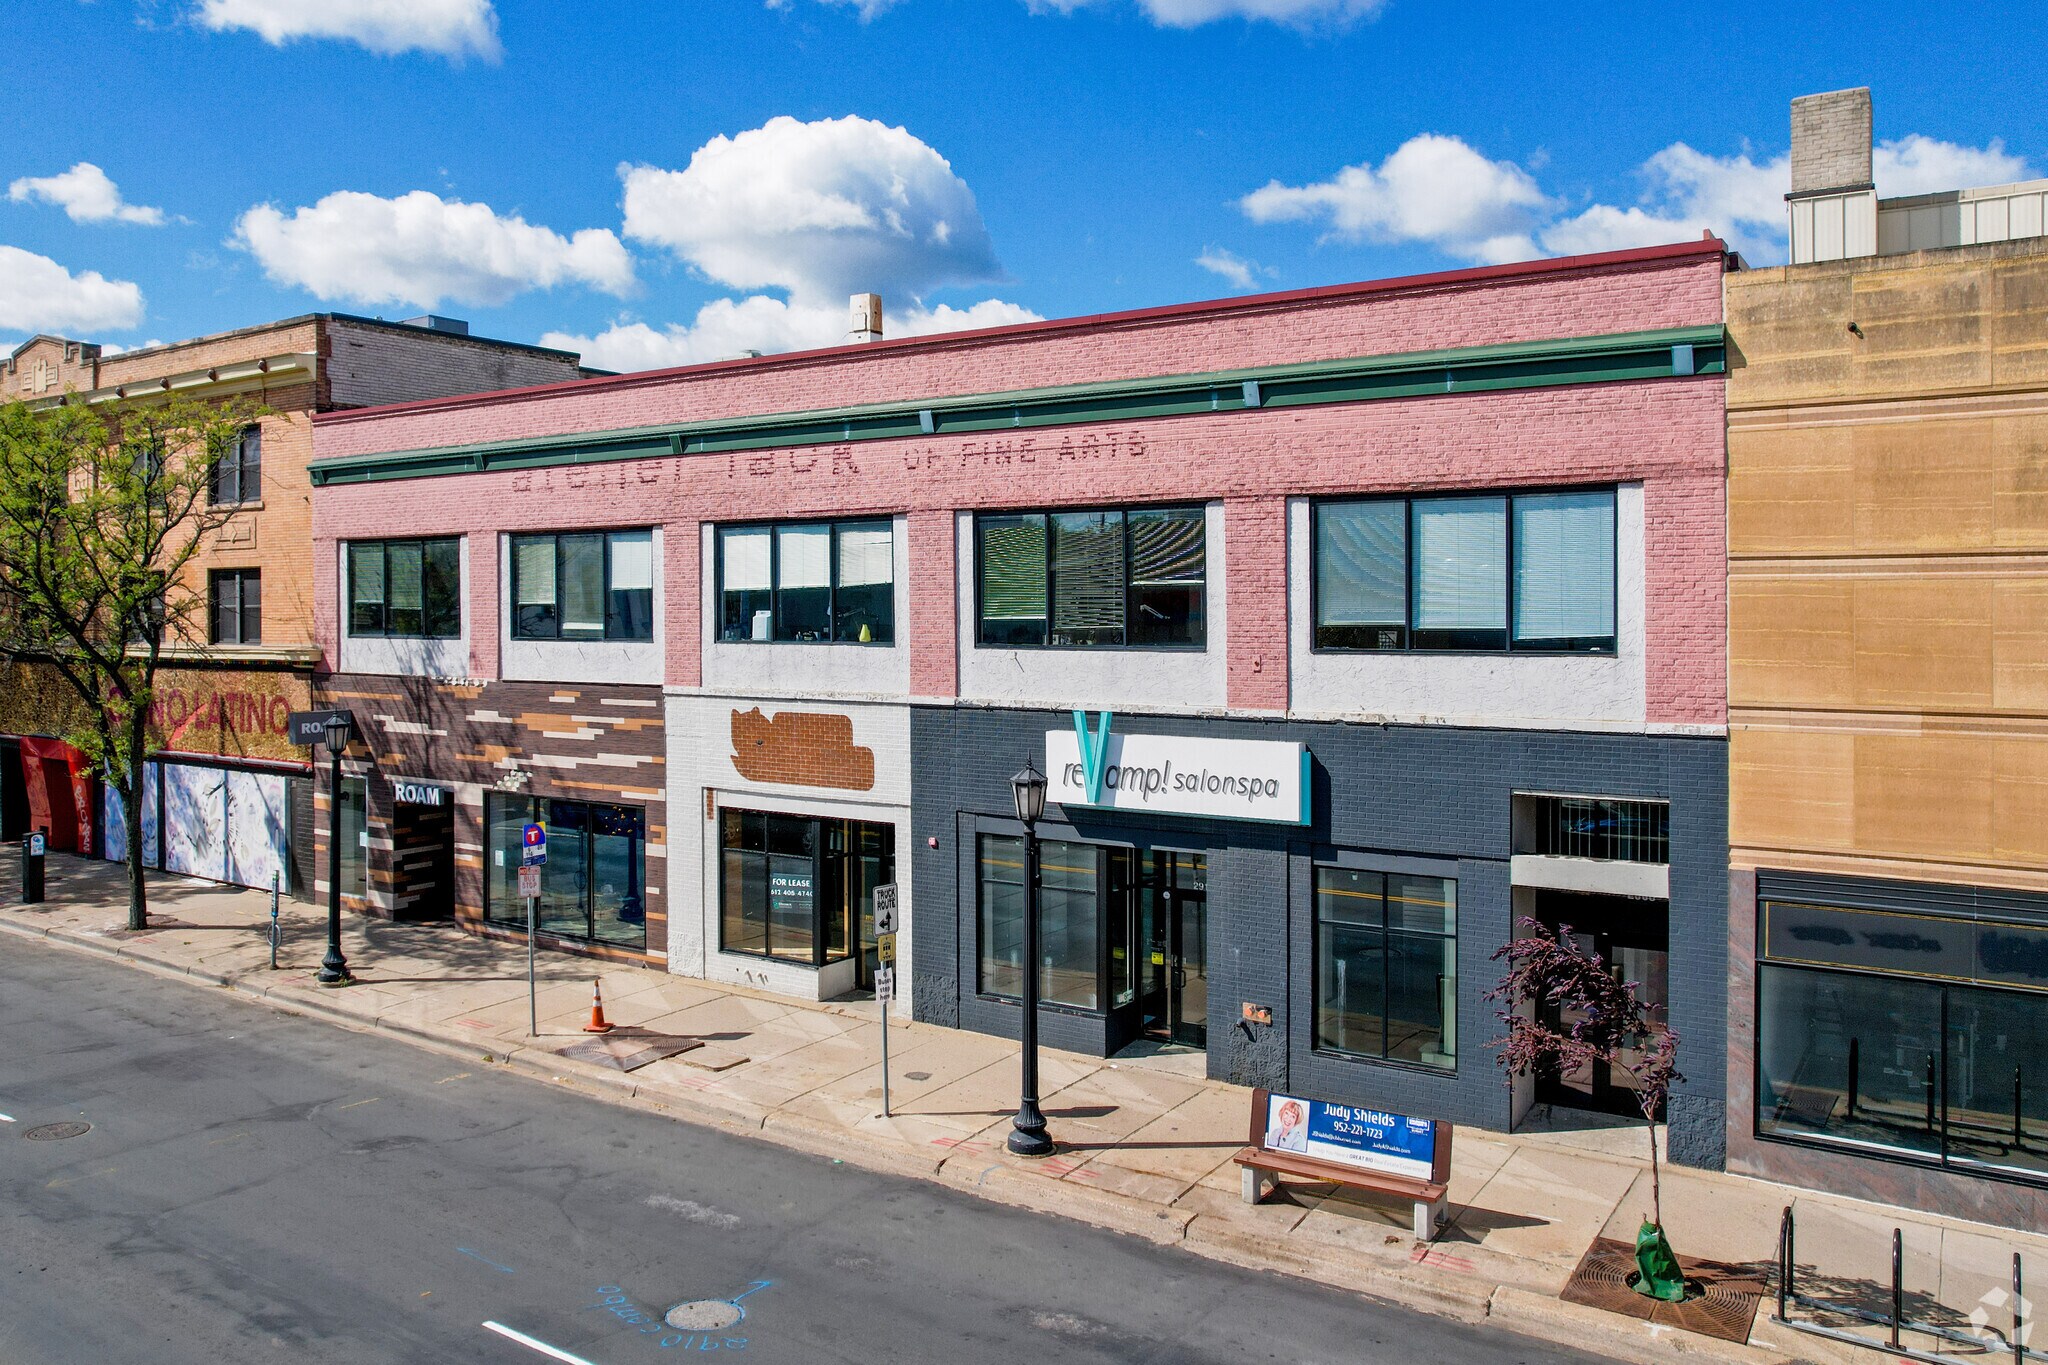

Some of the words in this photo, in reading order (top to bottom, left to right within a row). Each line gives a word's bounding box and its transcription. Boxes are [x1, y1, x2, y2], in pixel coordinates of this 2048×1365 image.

[1056, 430, 1146, 461] ARTS
[107, 687, 188, 728] CNO
[194, 690, 291, 736] LATINO
[301, 722, 324, 734] RO
[395, 783, 440, 805] ROAM
[1173, 768, 1280, 803] salonspa
[772, 878, 786, 886] FOR
[788, 879, 810, 887] LEASE
[877, 888, 896, 900] TRUCK
[877, 898, 896, 911] ROUTE
[1323, 1103, 1351, 1122] Judy
[1354, 1108, 1396, 1127] Shields
[1333, 1121, 1384, 1139] 952-221-1723
[1350, 1154, 1364, 1162] GREAT
